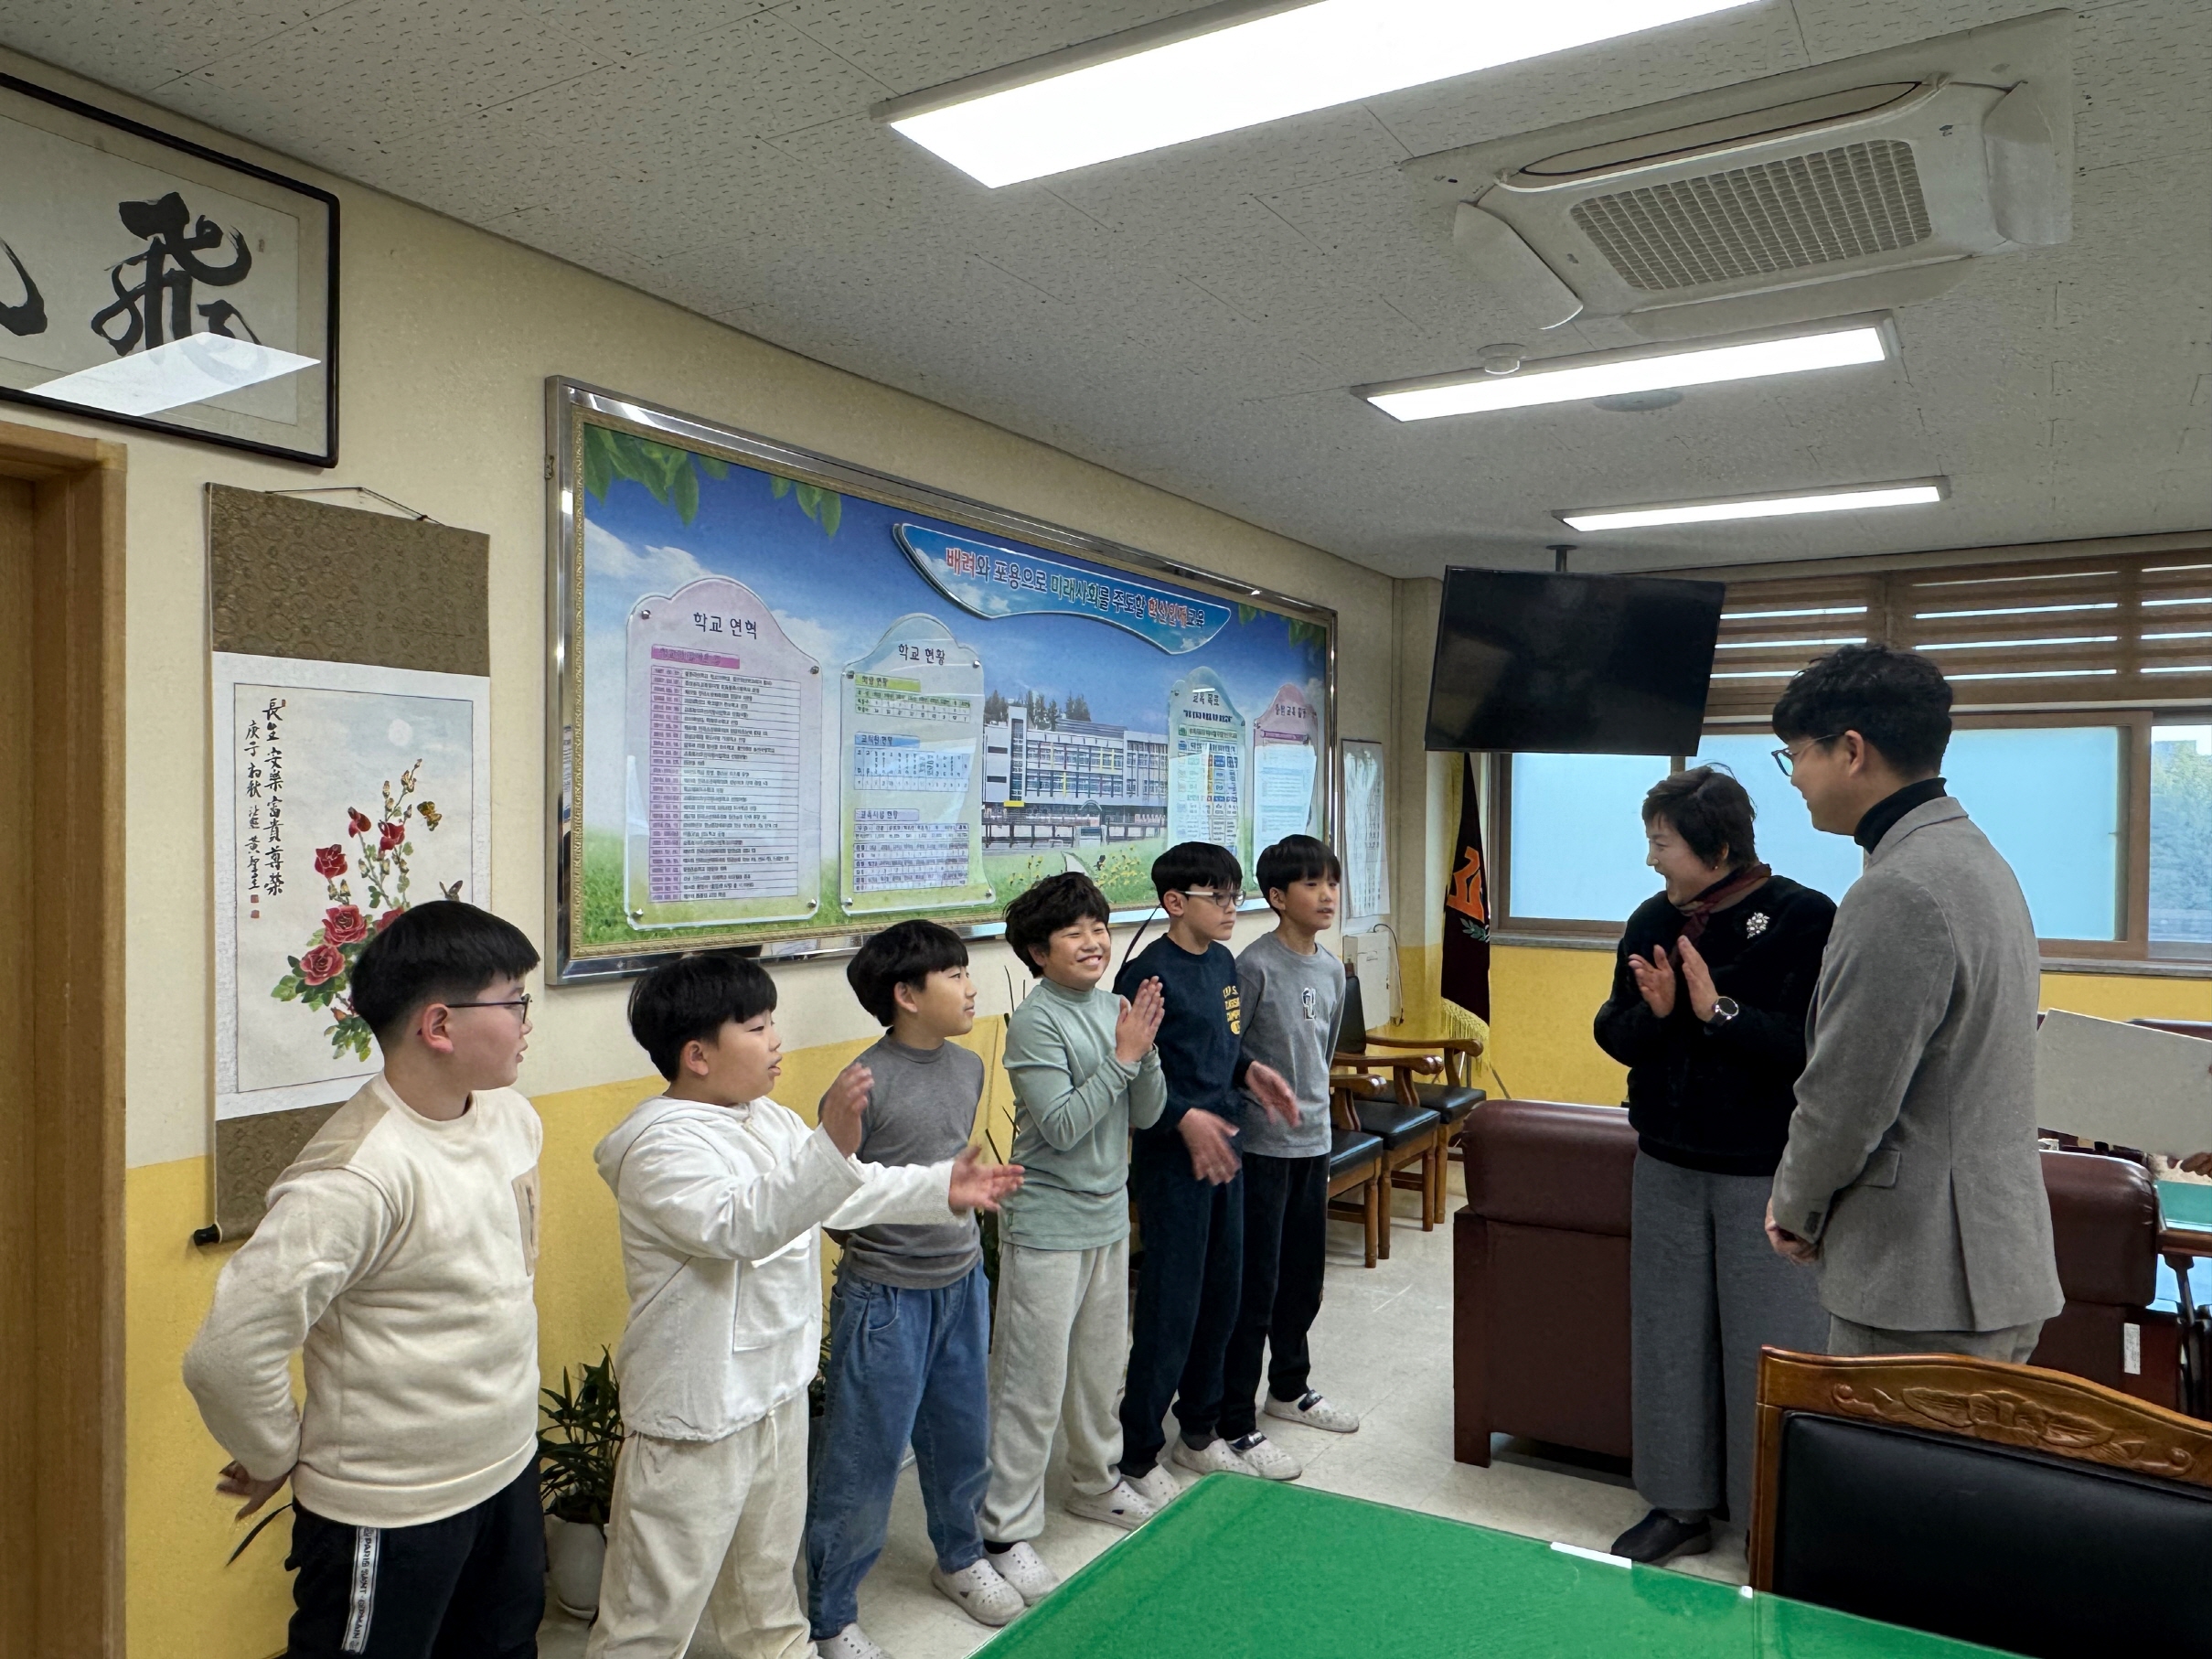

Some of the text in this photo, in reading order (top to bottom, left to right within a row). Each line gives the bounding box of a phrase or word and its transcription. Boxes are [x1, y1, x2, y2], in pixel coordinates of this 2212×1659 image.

[945, 547, 1205, 627] 배려와 포용으로 미래사회를 주도할 혁신인재교육
[693, 612, 757, 640] 학교 연혁
[898, 643, 946, 666] 학교 현황
[886, 809, 899, 819] 현황
